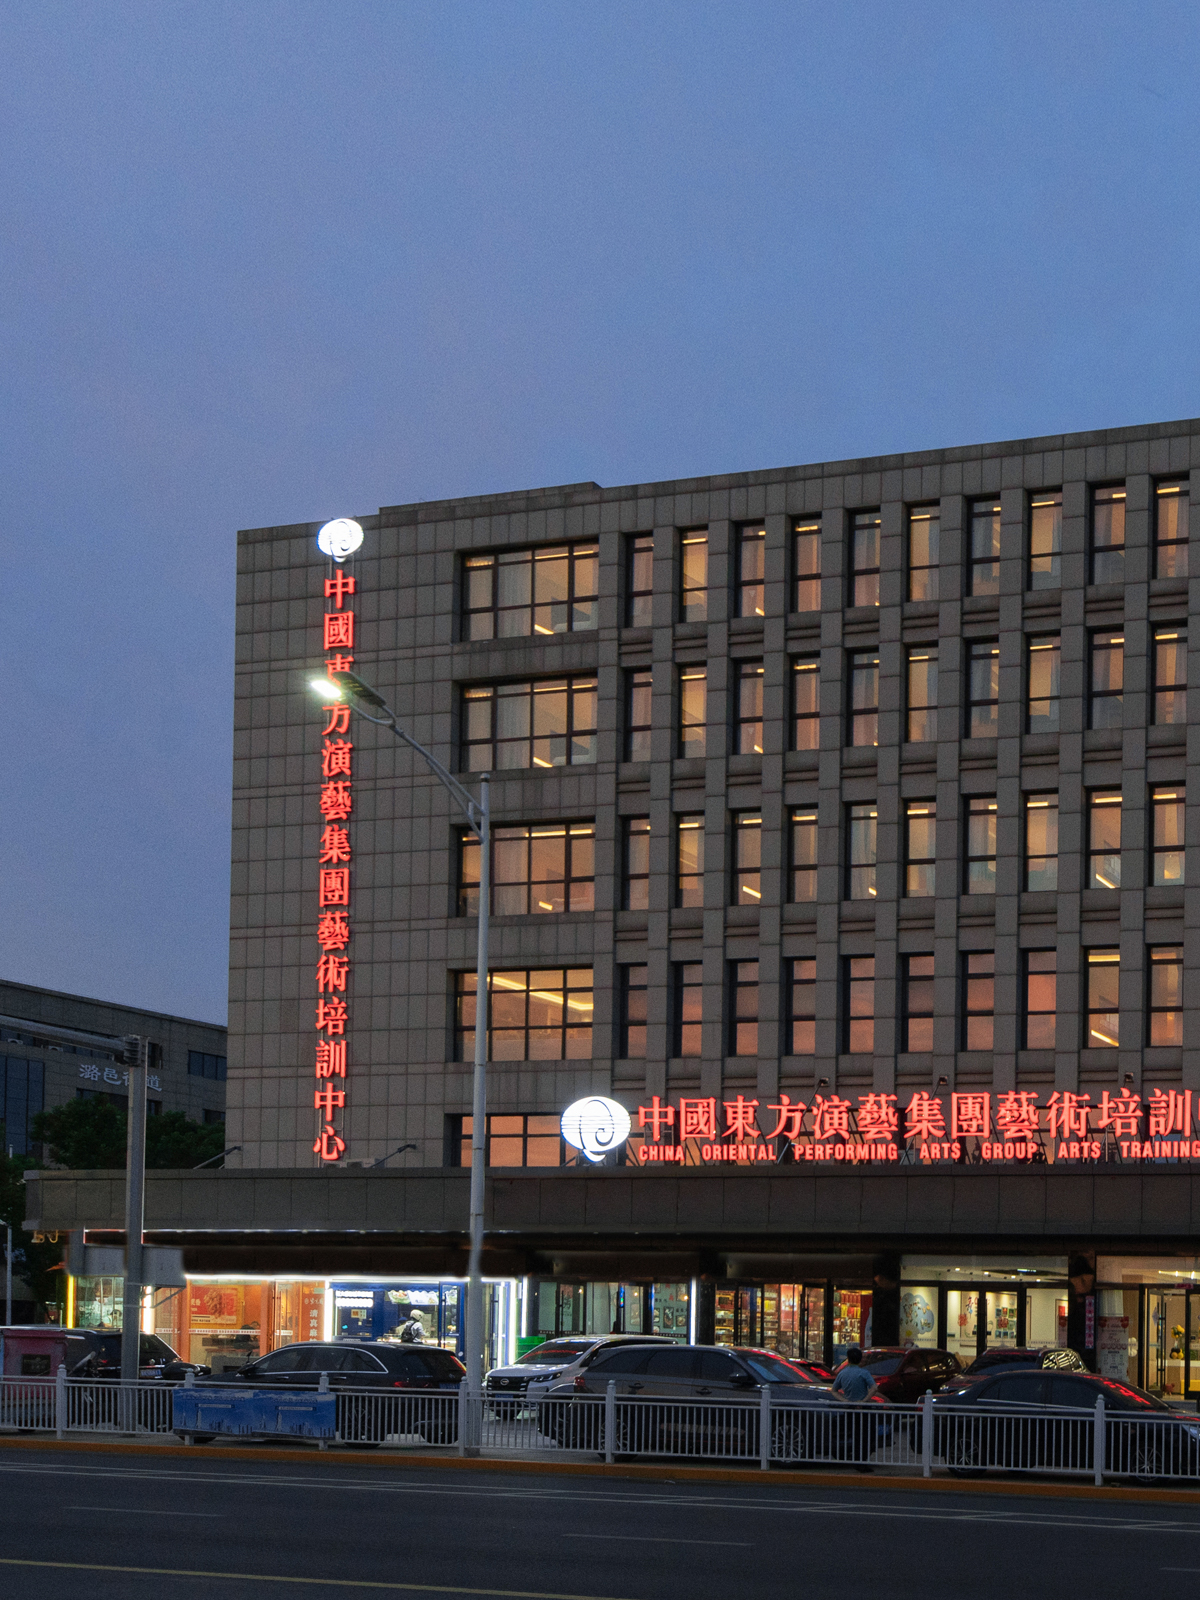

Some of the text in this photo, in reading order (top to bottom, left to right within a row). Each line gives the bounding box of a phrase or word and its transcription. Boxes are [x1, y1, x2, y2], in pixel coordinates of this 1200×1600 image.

[639, 1145, 685, 1161] CHINA
[701, 1144, 776, 1161] ORIENTAL
[794, 1143, 898, 1160] PERFORMING
[919, 1142, 961, 1159] ARTS
[981, 1142, 1038, 1159] GROUP
[1058, 1141, 1101, 1159] ARTS
